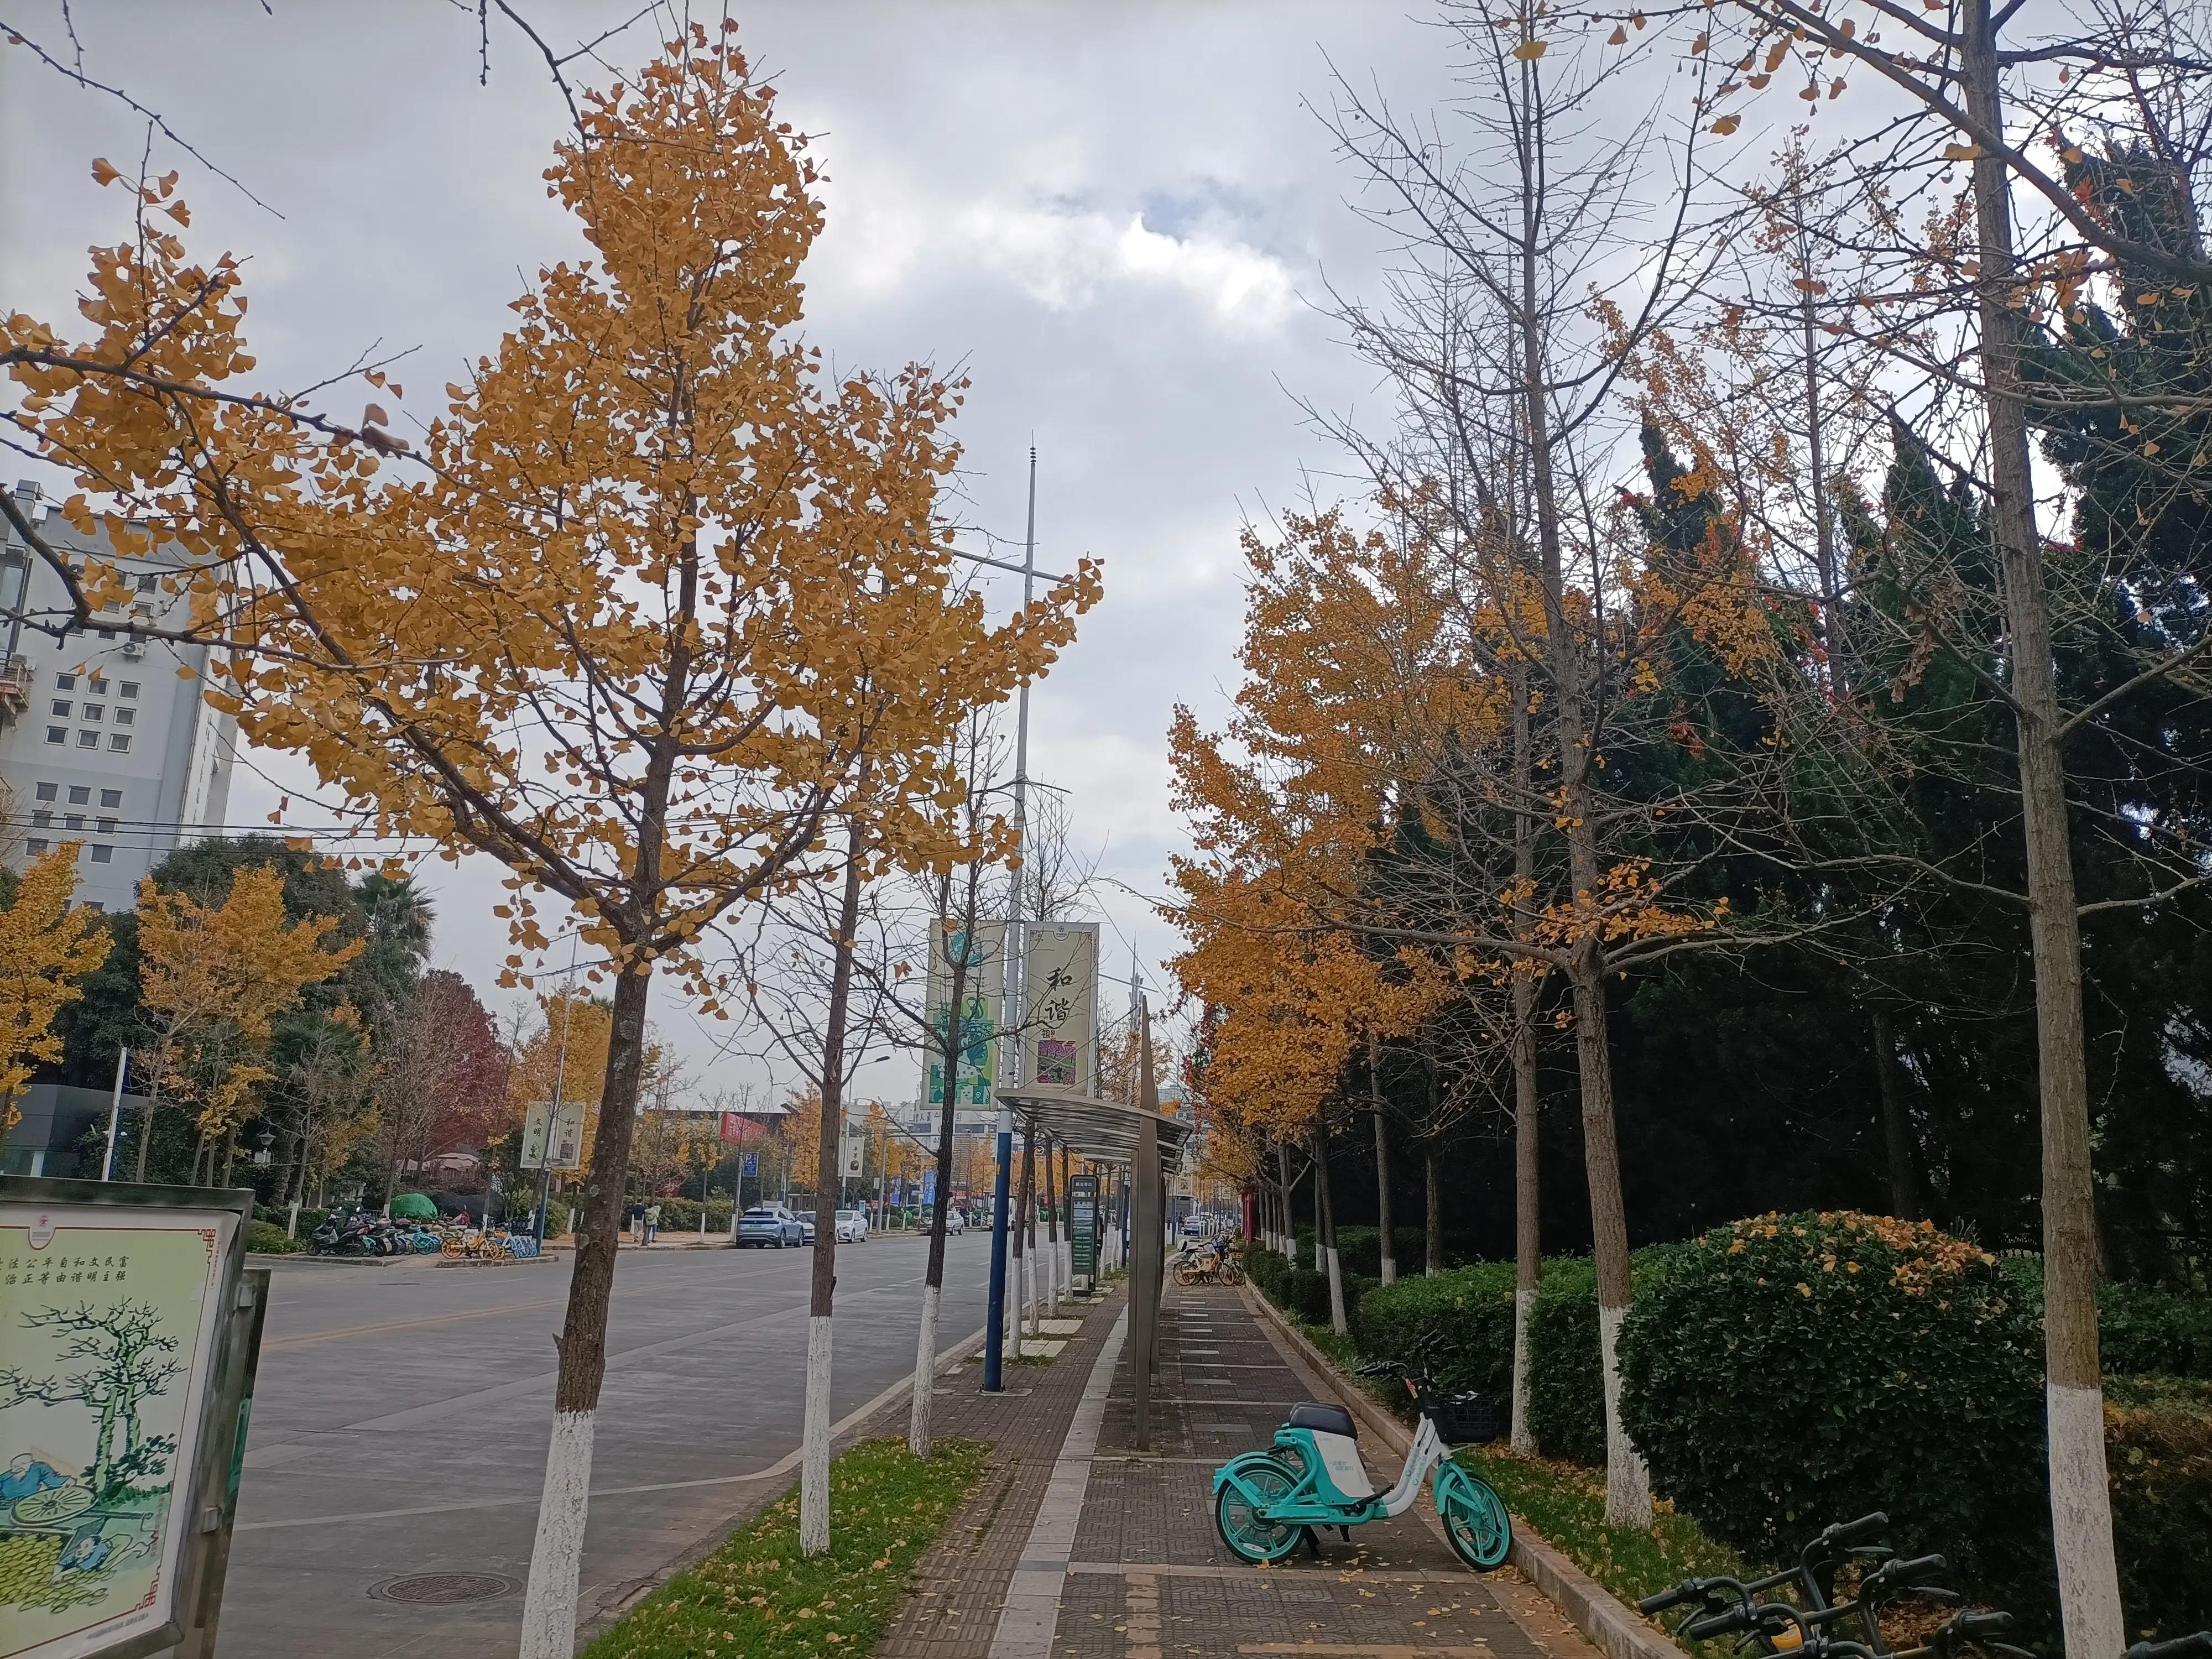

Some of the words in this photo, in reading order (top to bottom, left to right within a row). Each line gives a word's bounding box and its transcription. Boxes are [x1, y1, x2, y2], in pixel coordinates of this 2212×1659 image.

[1045, 967, 1072, 1021] 和谐
[533, 1117, 542, 1137] 文明
[564, 1118, 575, 1138] 和谐
[745, 1154, 752, 1164] P
